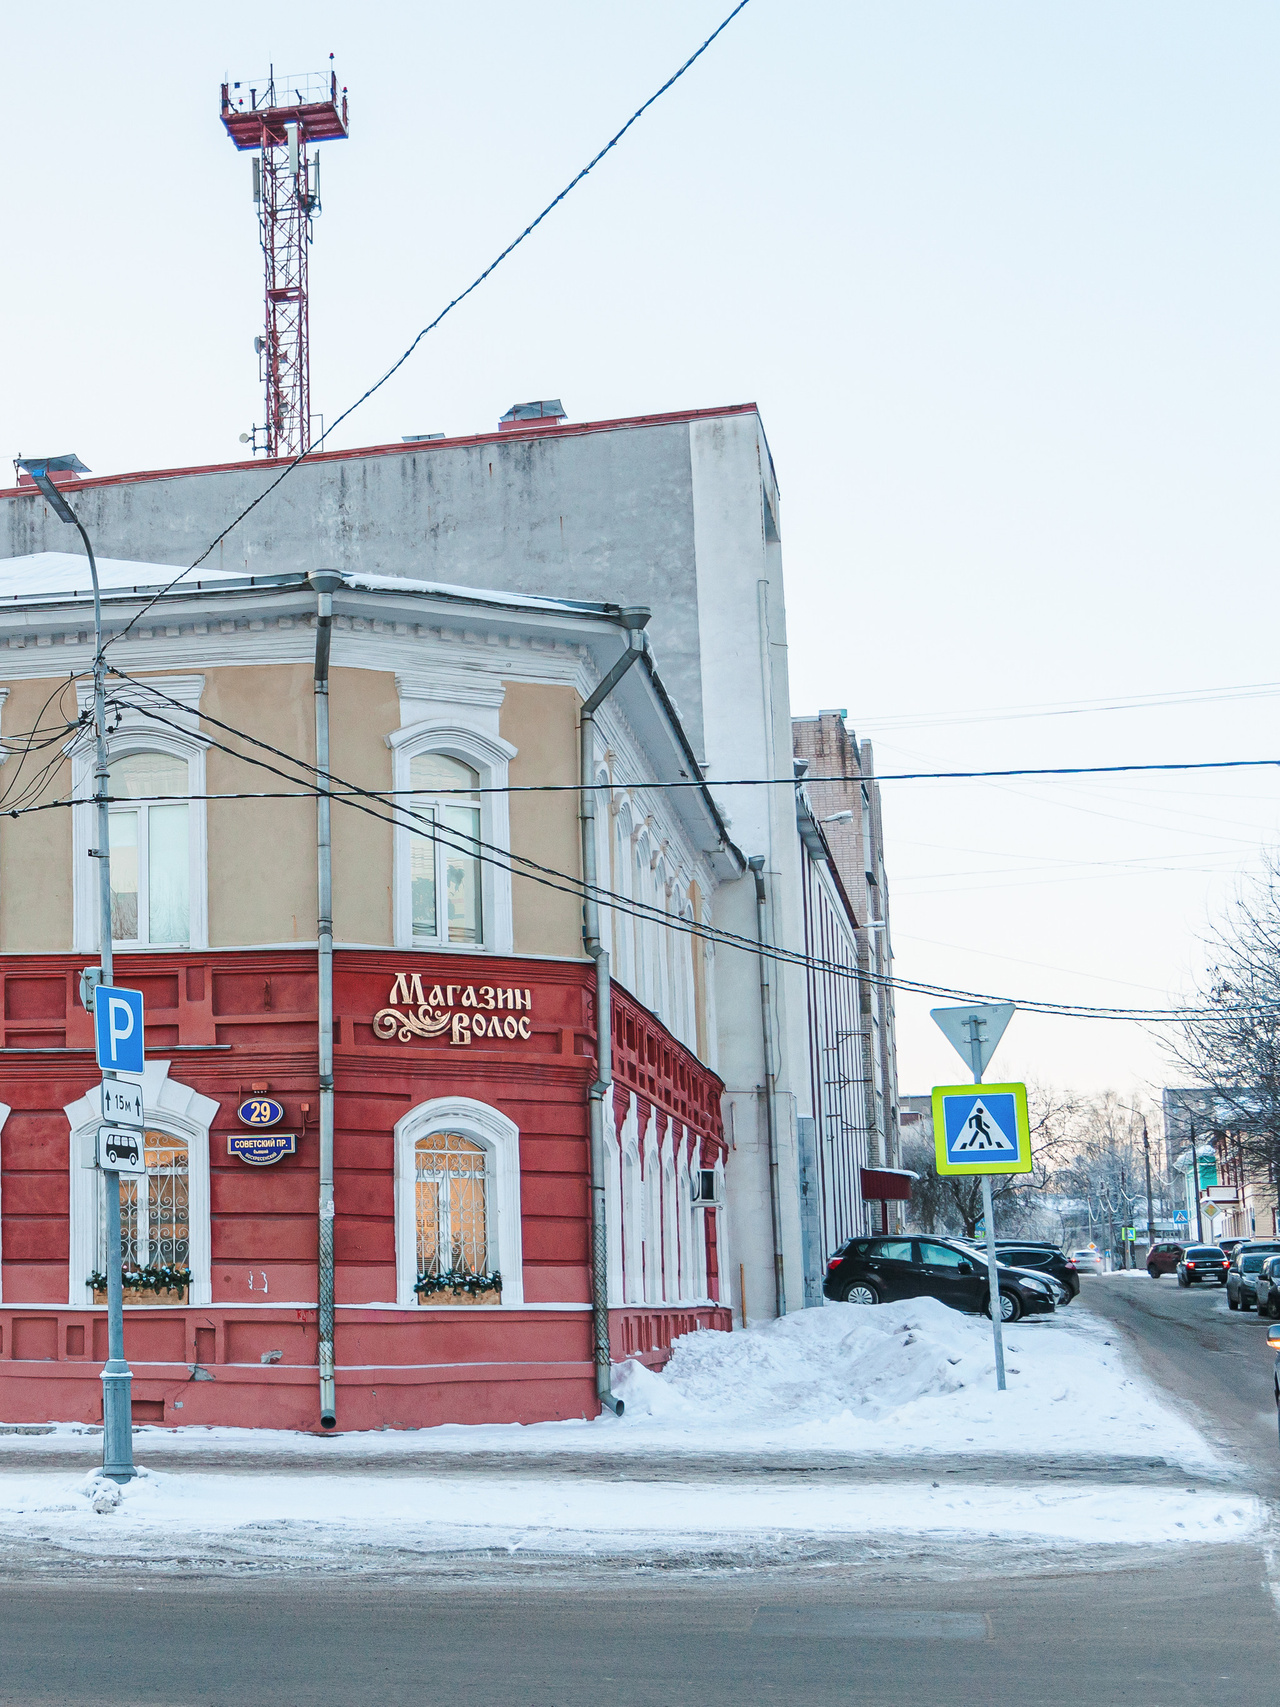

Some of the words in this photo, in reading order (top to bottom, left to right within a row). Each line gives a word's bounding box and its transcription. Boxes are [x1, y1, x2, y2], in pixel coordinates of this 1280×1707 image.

[389, 972, 532, 1010] Магазин
[250, 1101, 271, 1122] 29
[234, 1138, 276, 1149] СОВЕТСКИЙ
[276, 1139, 289, 1148] ПР.
